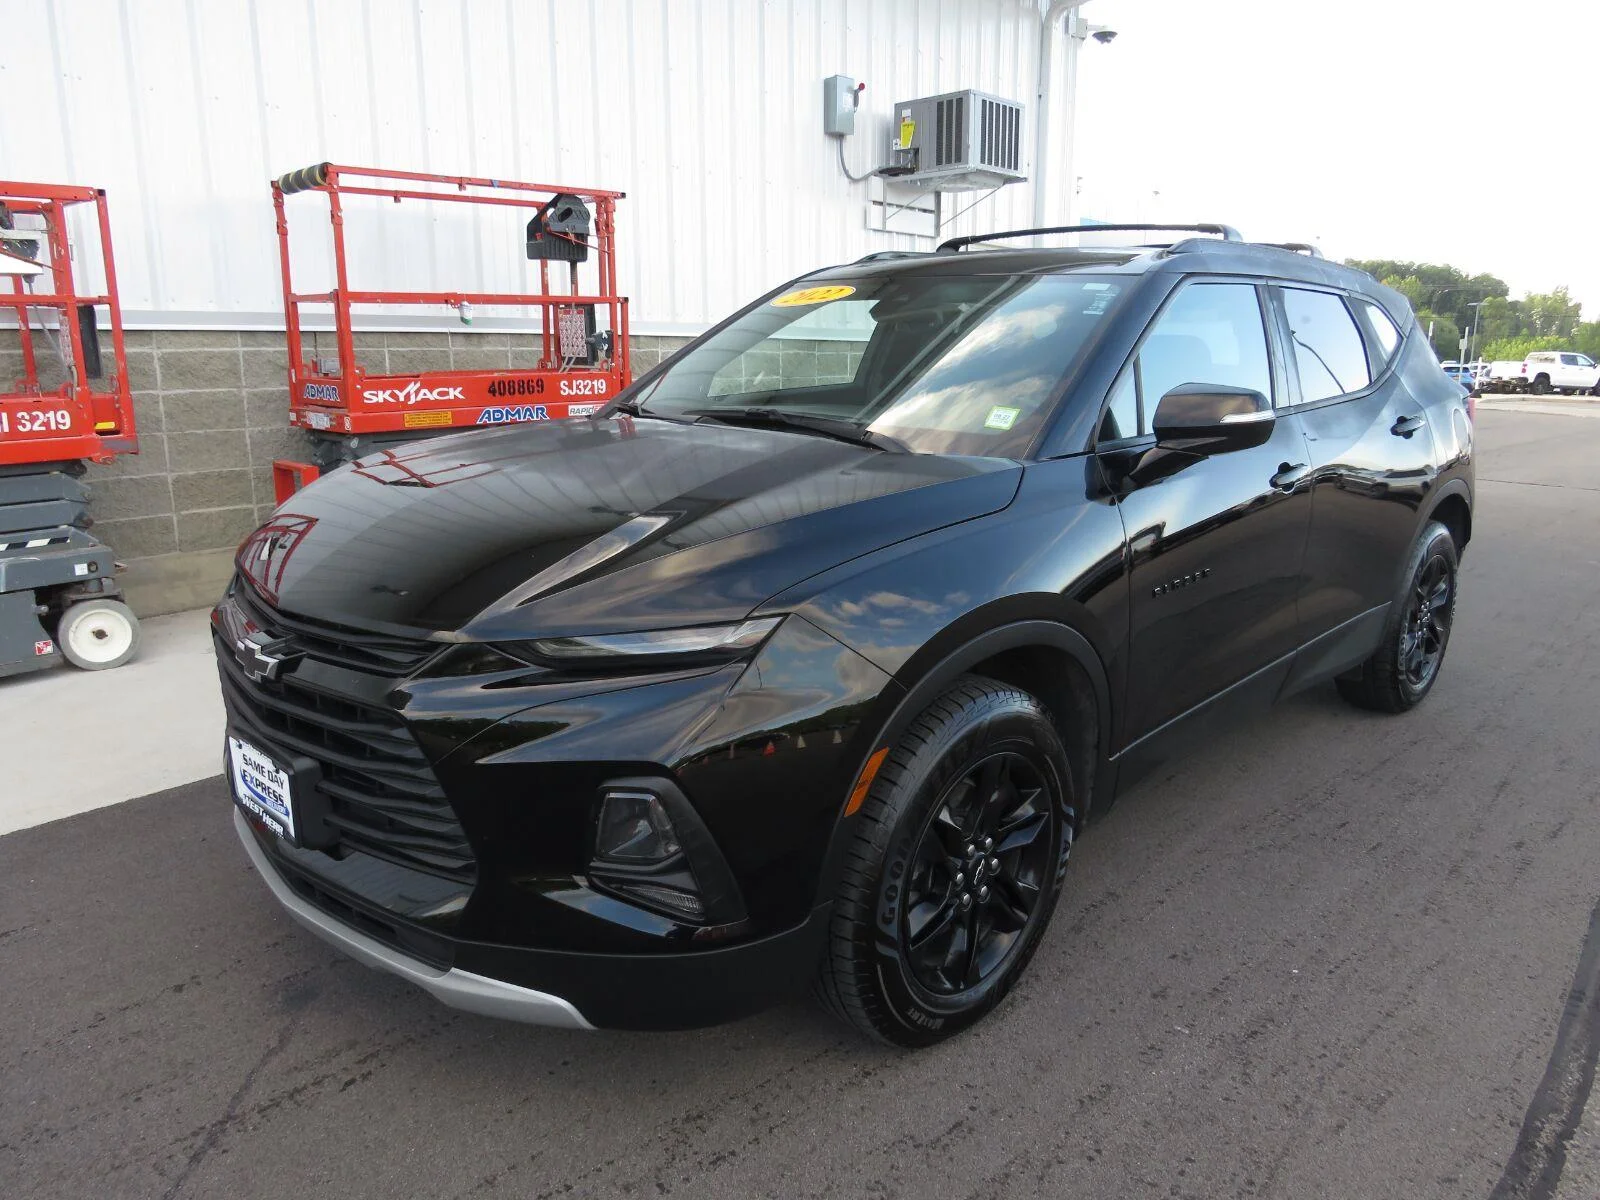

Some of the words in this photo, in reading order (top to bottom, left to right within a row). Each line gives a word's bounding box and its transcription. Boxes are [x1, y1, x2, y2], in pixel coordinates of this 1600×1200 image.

[304, 384, 340, 401] ADMAR
[363, 381, 466, 404] SKYJACK
[488, 379, 544, 396] 408869
[560, 379, 606, 395] SJ3219
[16, 410, 71, 432] 3219
[476, 405, 549, 424] ADMAR
[242, 754, 266, 777] SAME
[267, 770, 285, 789] DAY
[242, 769, 285, 807] EXPRESS
[242, 794, 264, 816] WEST
[262, 814, 284, 836] HERR
